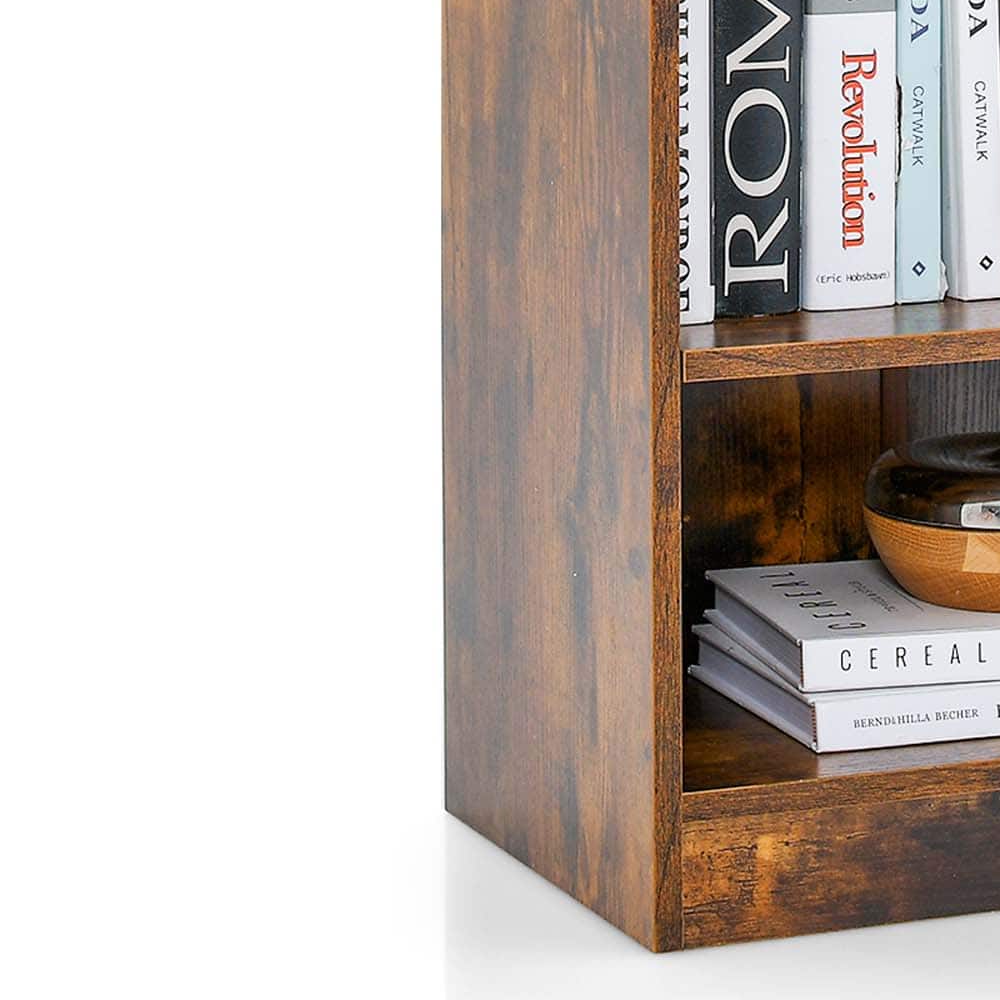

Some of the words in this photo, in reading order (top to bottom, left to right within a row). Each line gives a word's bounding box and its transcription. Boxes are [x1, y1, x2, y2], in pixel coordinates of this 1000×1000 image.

[841, 48, 878, 251] Revolution
[911, 85, 925, 167] CATWALK
[974, 80, 988, 162] CATWALK
[759, 570, 867, 630] CEREAL
[840, 642, 987, 672] CEREAL
[935, 708, 979, 721] BECHER
